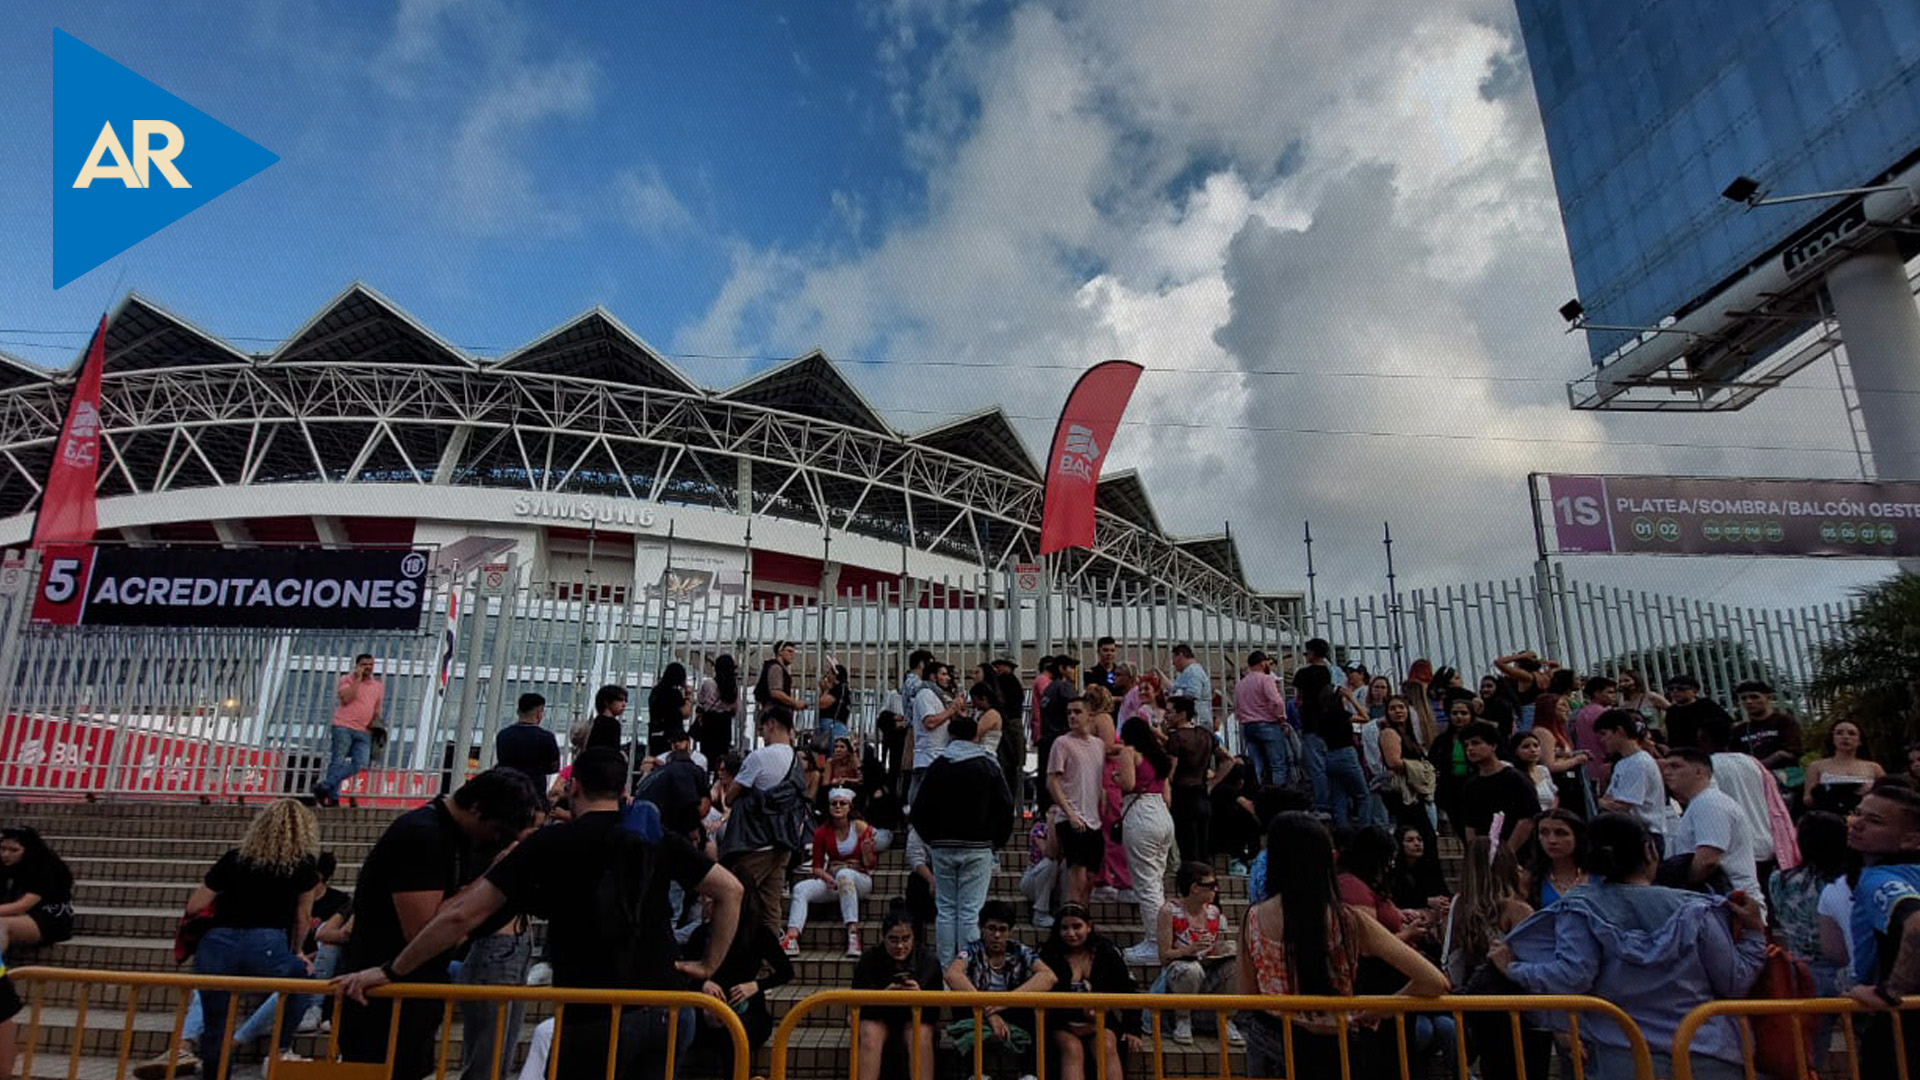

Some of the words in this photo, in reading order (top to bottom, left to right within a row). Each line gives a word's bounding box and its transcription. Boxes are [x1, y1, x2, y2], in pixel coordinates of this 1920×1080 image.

[514, 496, 655, 527] SAMSUNG
[1556, 496, 1601, 526] 1S
[1616, 498, 1865, 517] PLATEA/SOMBRA/BALCÓN
[1635, 524, 1651, 535] 01
[1660, 524, 1678, 535] 02
[44, 559, 79, 602] 5
[92, 576, 417, 609] ACREDITACIONES
